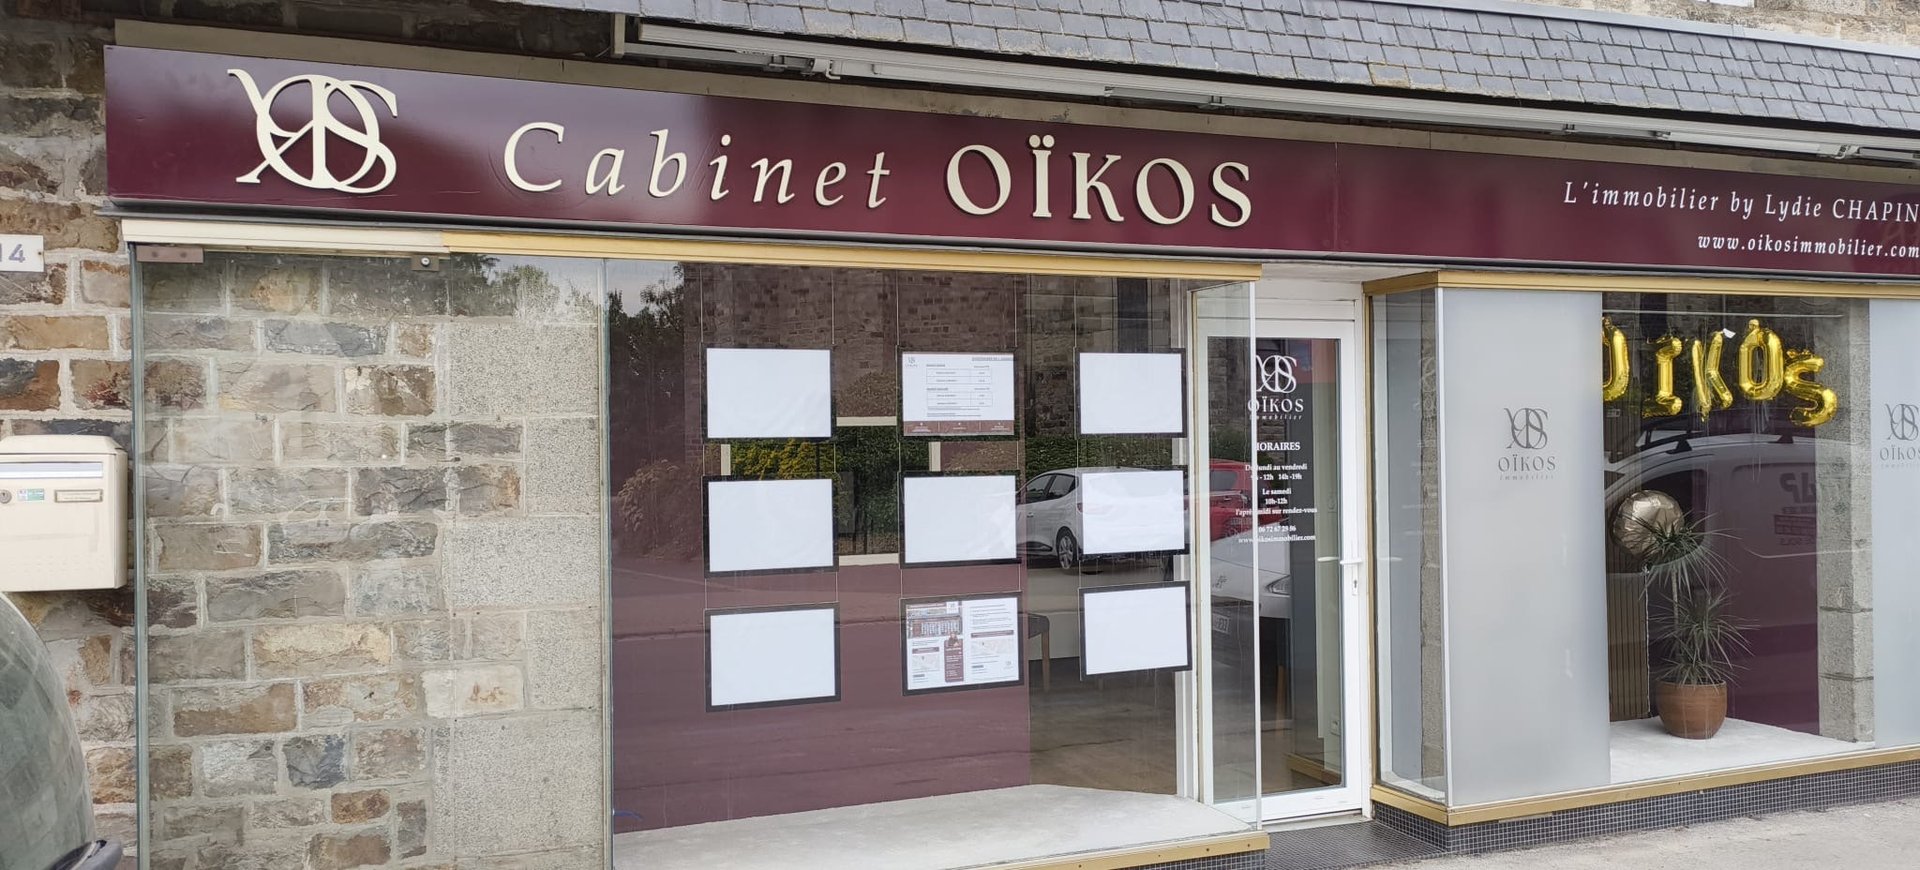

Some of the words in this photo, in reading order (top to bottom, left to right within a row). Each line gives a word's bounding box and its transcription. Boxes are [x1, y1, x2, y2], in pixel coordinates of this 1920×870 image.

[504, 121, 891, 208] Cabinet
[947, 134, 1252, 227] OÏKOS
[1564, 181, 1719, 211] L'immobilier
[1730, 191, 1754, 220] by
[1765, 194, 1822, 222] Lydie
[1832, 198, 1920, 223] CHAPIN
[1698, 234, 1920, 259] www.oikosimmobilier.com
[1498, 453, 1556, 472] OÏKOS
[1271, 487, 1292, 495] samedi
[1282, 506, 1318, 514] rendez-vous
